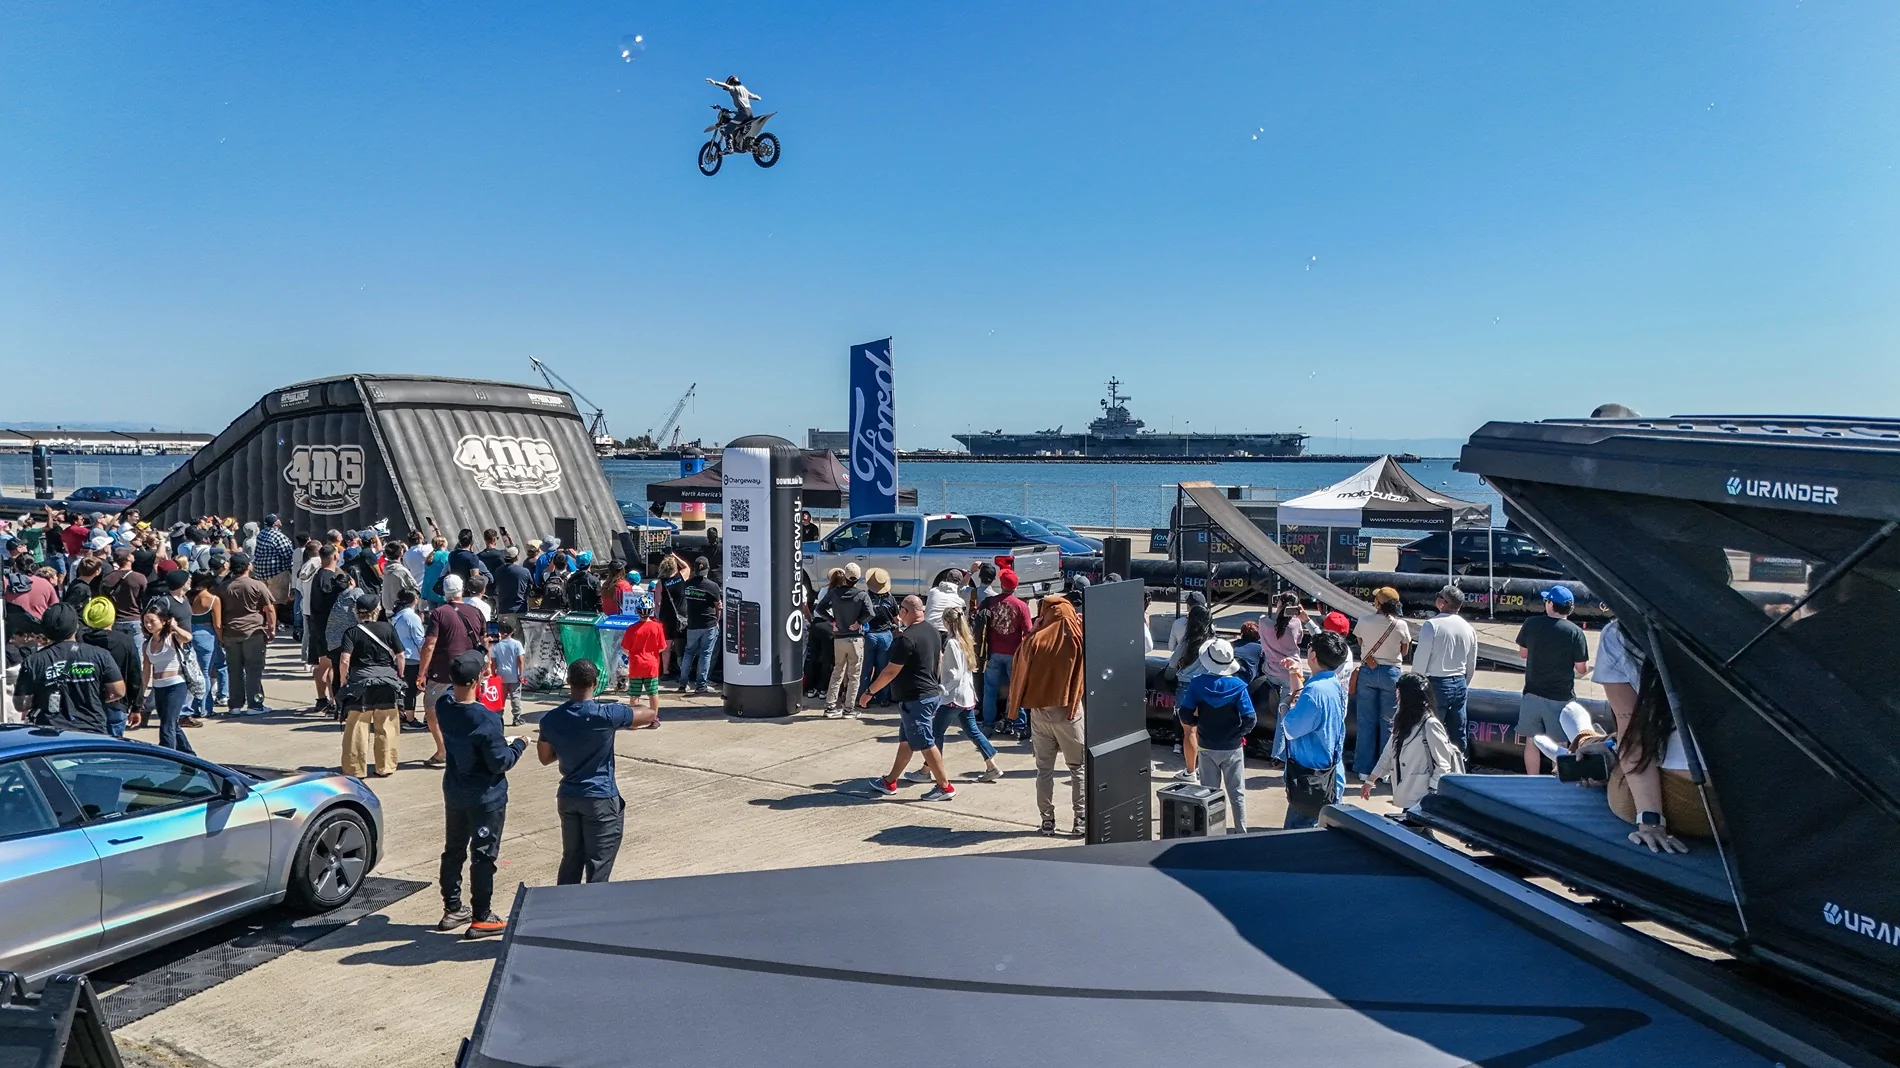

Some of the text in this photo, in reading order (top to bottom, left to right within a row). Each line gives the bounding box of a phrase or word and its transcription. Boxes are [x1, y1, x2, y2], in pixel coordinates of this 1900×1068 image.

[853, 349, 896, 496] Ford
[1746, 479, 1839, 505] URANDER
[1223, 578, 1244, 588] EXPO
[1500, 595, 1523, 606] EXPO
